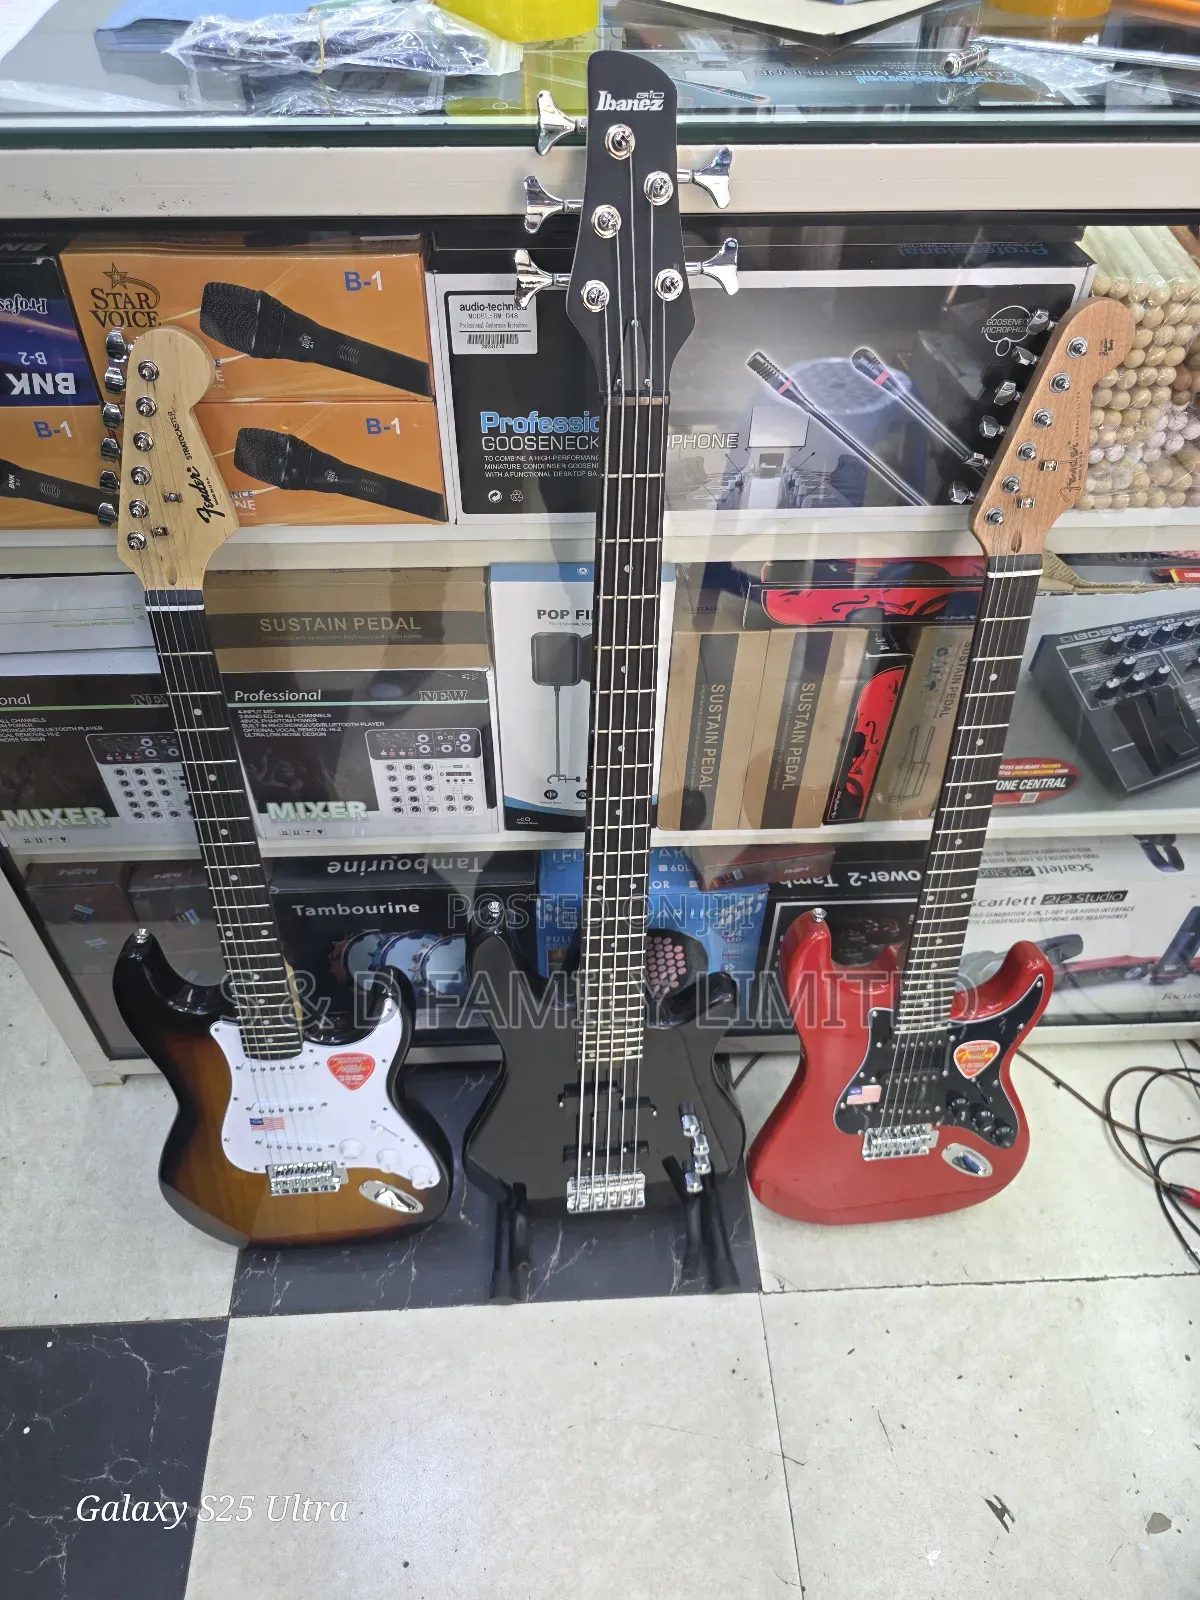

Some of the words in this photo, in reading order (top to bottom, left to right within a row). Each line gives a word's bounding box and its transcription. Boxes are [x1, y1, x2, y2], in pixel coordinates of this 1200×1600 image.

[595, 90, 664, 110] Ibanez
[343, 270, 383, 292] B-1
[90, 287, 151, 310] STAR
[89, 310, 161, 328] VOICE
[981, 326, 1028, 334] MICROPHO
[18, 351, 47, 365] B-2
[5, 373, 76, 395] BNK
[34, 420, 72, 438] B-1
[168, 411, 193, 461] STRATOCASTER
[365, 417, 401, 435] B-1
[187, 466, 225, 524] Fender
[259, 618, 348, 632] SUSTAIN
[354, 617, 422, 630] PEDAL
[537, 609, 570, 620] POP
[1073, 626, 1125, 640] BOSS
[955, 641, 972, 684] SUSTAIN
[234, 690, 321, 701] Professional
[419, 690, 468, 702] NEW
[939, 685, 958, 718] PEDAL
[704, 684, 725, 744] SUSTAIN
[790, 682, 816, 743] SUSTAIN
[699, 748, 716, 790] PEDAL
[782, 748, 802, 790] PEDAL
[1019, 777, 1066, 789] CENTRAL
[1, 807, 108, 829] MIXER
[266, 801, 369, 822] MIXER
[327, 855, 483, 876] Tambourine
[1036, 863, 1094, 874] Scarlett
[1076, 891, 1124, 903] Studio
[292, 902, 420, 916] Tambourine
